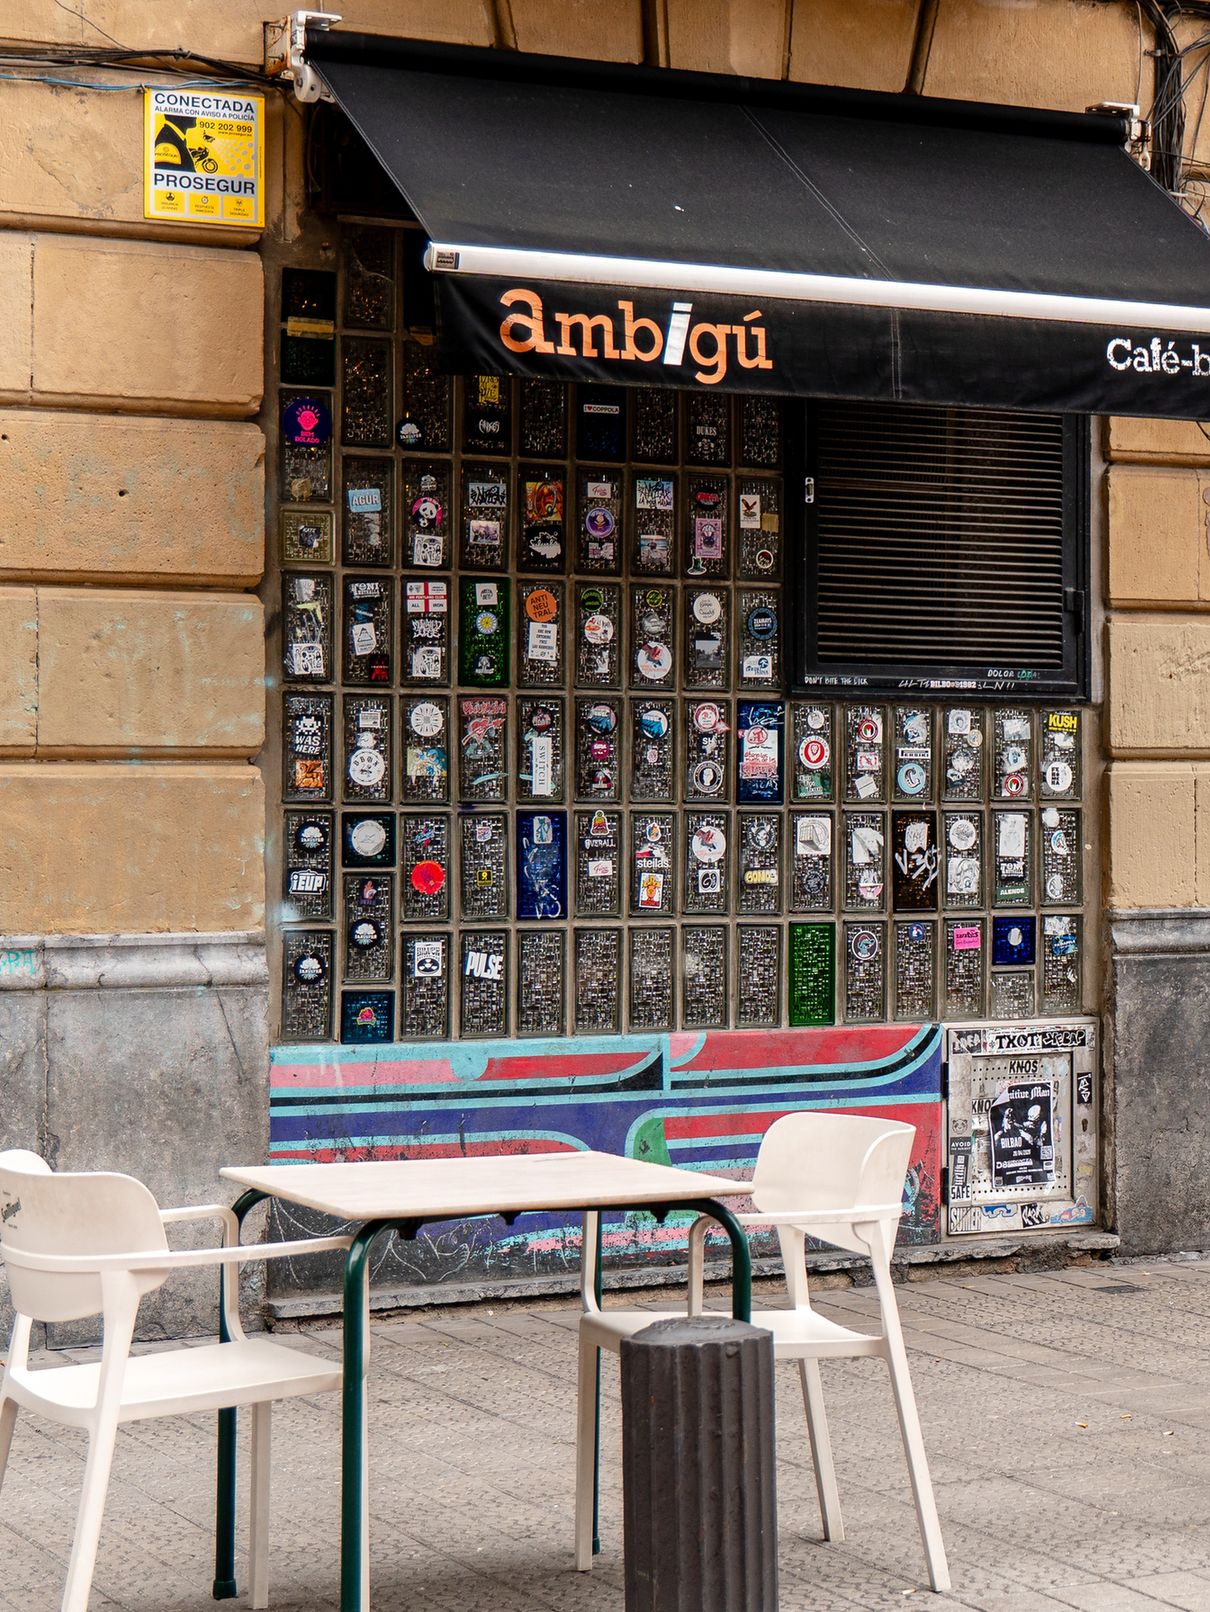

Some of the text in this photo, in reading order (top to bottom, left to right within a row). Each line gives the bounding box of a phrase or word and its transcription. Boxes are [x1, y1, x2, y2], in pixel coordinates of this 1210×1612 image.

[154, 93, 255, 114] CONECTADA
[154, 105, 184, 114] ALARMA
[185, 108, 200, 116] CON
[200, 110, 221, 118] AVISO
[228, 112, 255, 121] POLICÍA
[200, 121, 252, 133] 902 202 999
[154, 173, 255, 195] PROSEGUR
[499, 287, 773, 385] ambigú
[351, 493, 379, 506] AGUR
[530, 594, 548, 605] ANTI
[532, 601, 549, 611] NEU
[533, 608, 553, 619] TRAL
[987, 669, 1014, 678] DOLOR
[1048, 714, 1078, 729] KUSH
[295, 735, 321, 746] WAS
[295, 744, 321, 755] HERE
[538, 745, 546, 785] SWITCH
[465, 950, 504, 979] PULSE
[950, 1185, 970, 1200] SAFE
